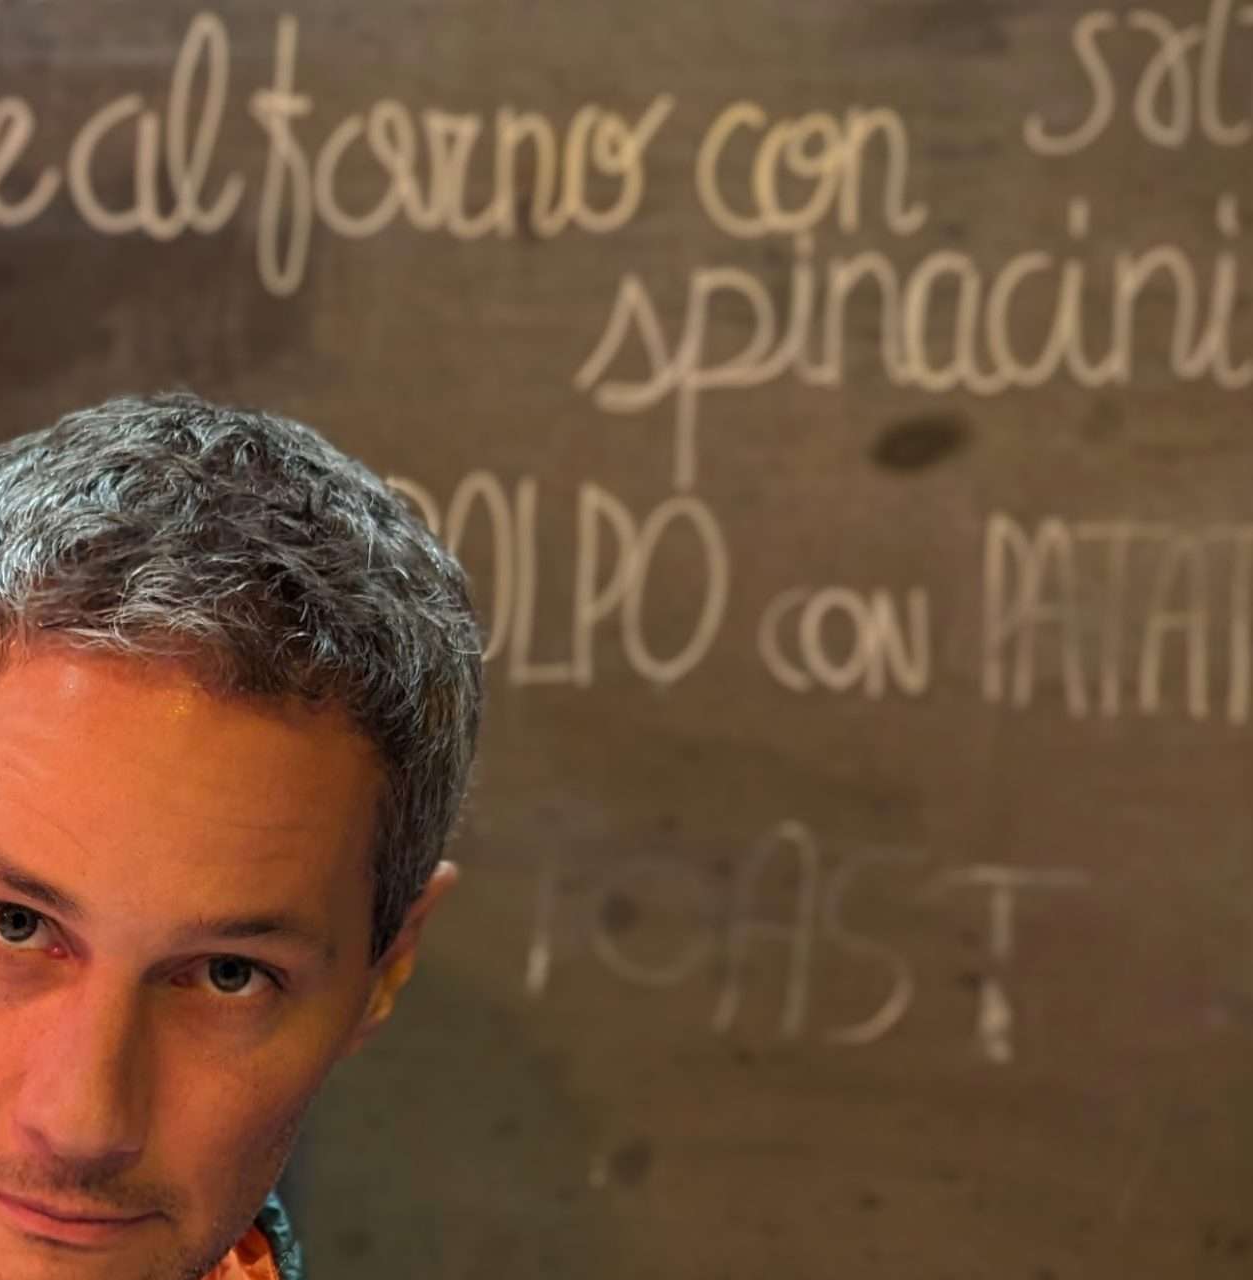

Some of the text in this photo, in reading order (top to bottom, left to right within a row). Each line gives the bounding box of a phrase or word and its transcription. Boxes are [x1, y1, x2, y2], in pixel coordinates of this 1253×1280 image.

[69, 12, 245, 241] al
[249, 14, 675, 297] forno
[695, 102, 927, 235] con
[574, 194, 1253, 495] spinacini
[387, 471, 729, 690] OLPO
